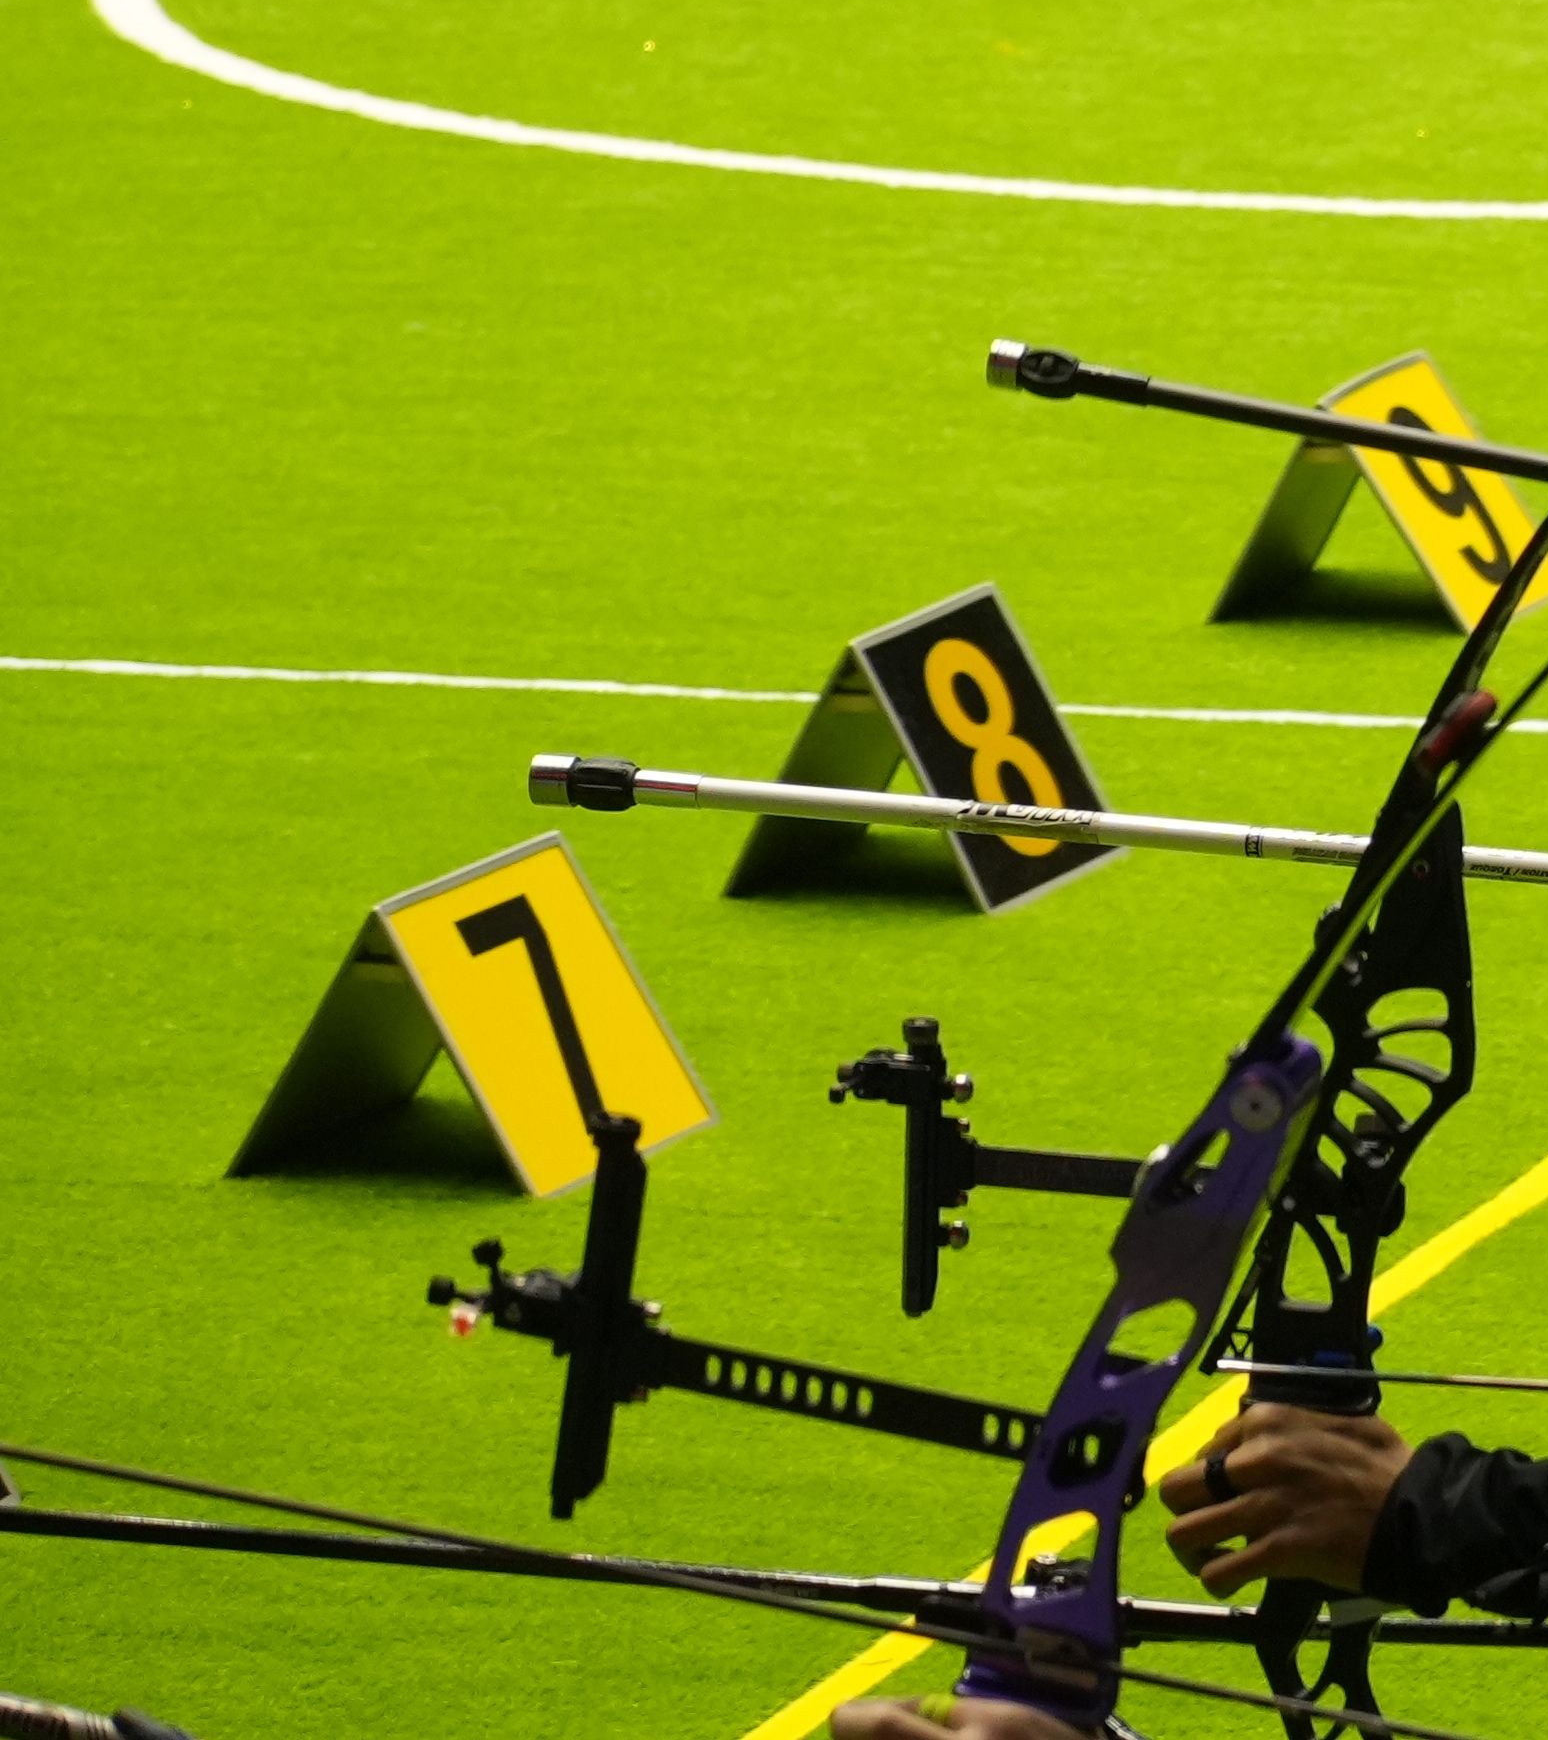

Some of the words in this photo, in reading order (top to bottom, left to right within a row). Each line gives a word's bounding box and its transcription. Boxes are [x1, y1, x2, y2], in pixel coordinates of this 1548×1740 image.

[1385, 404, 1514, 584] 9
[923, 637, 1063, 857] 8
[453, 893, 607, 1136] 7
